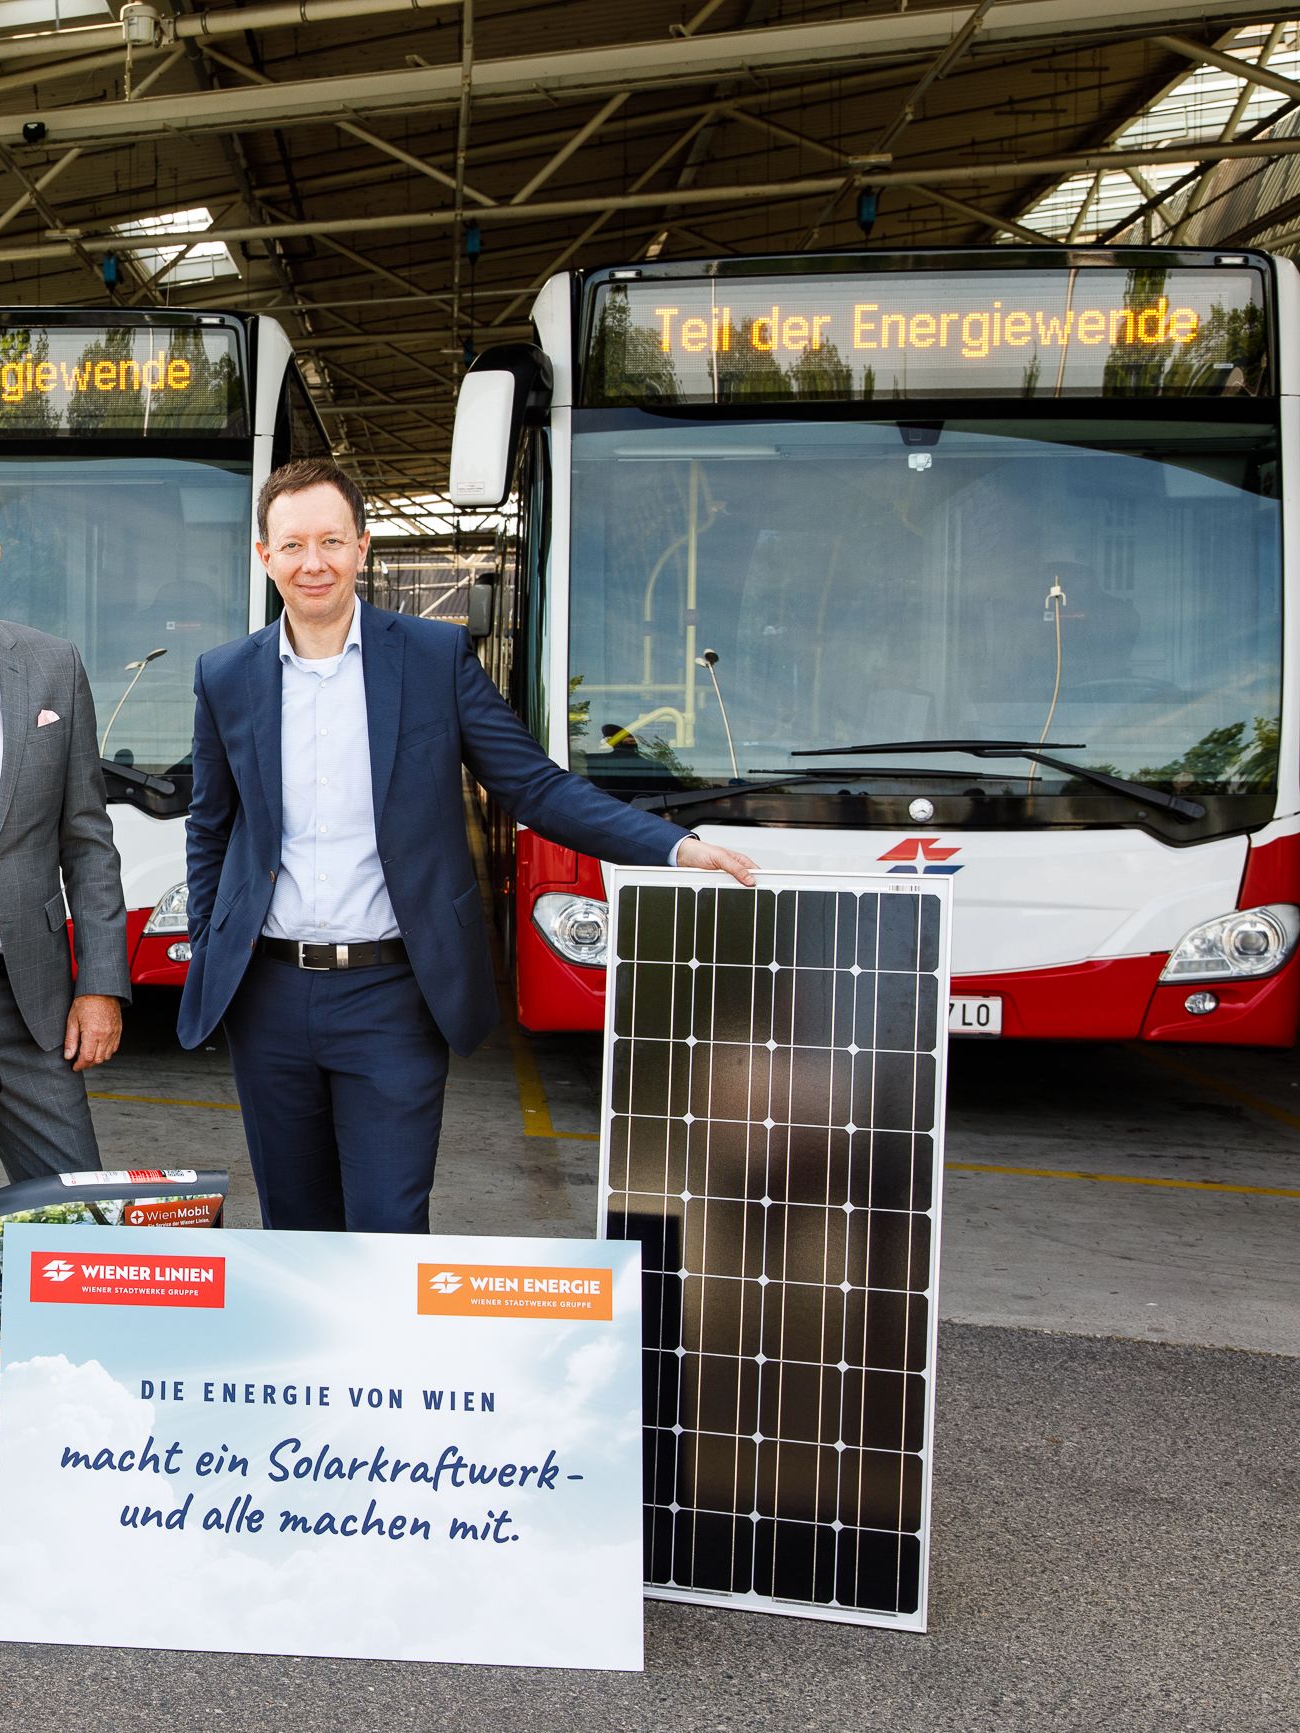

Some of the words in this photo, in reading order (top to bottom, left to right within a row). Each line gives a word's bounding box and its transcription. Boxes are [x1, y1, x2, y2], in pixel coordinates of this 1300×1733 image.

[654, 307, 731, 352] Teil
[752, 305, 831, 351] der
[853, 297, 1200, 358] Energiewende
[146, 1205, 210, 1222] WienMobil
[81, 1264, 151, 1281] WIENER
[155, 1267, 214, 1283] LINIEN
[114, 1287, 165, 1295] STADTWERKE
[168, 1288, 199, 1296] GRUPPE
[469, 1276, 519, 1292] WIEN
[523, 1278, 601, 1295] ENERGIE
[470, 1298, 502, 1306] WIENER
[504, 1299, 557, 1308] STADTWERKE
[559, 1301, 592, 1309] GRUPPE
[141, 1379, 185, 1402] DIE
[203, 1382, 330, 1407] ENERGIE
[348, 1387, 403, 1409] VON
[422, 1389, 496, 1413] WIEN
[60, 1435, 184, 1475] macht
[195, 1443, 249, 1477] ein
[120, 1492, 195, 1530] und
[202, 1493, 265, 1534] alle
[279, 1498, 431, 1541] machen
[449, 1510, 520, 1544] mit.
